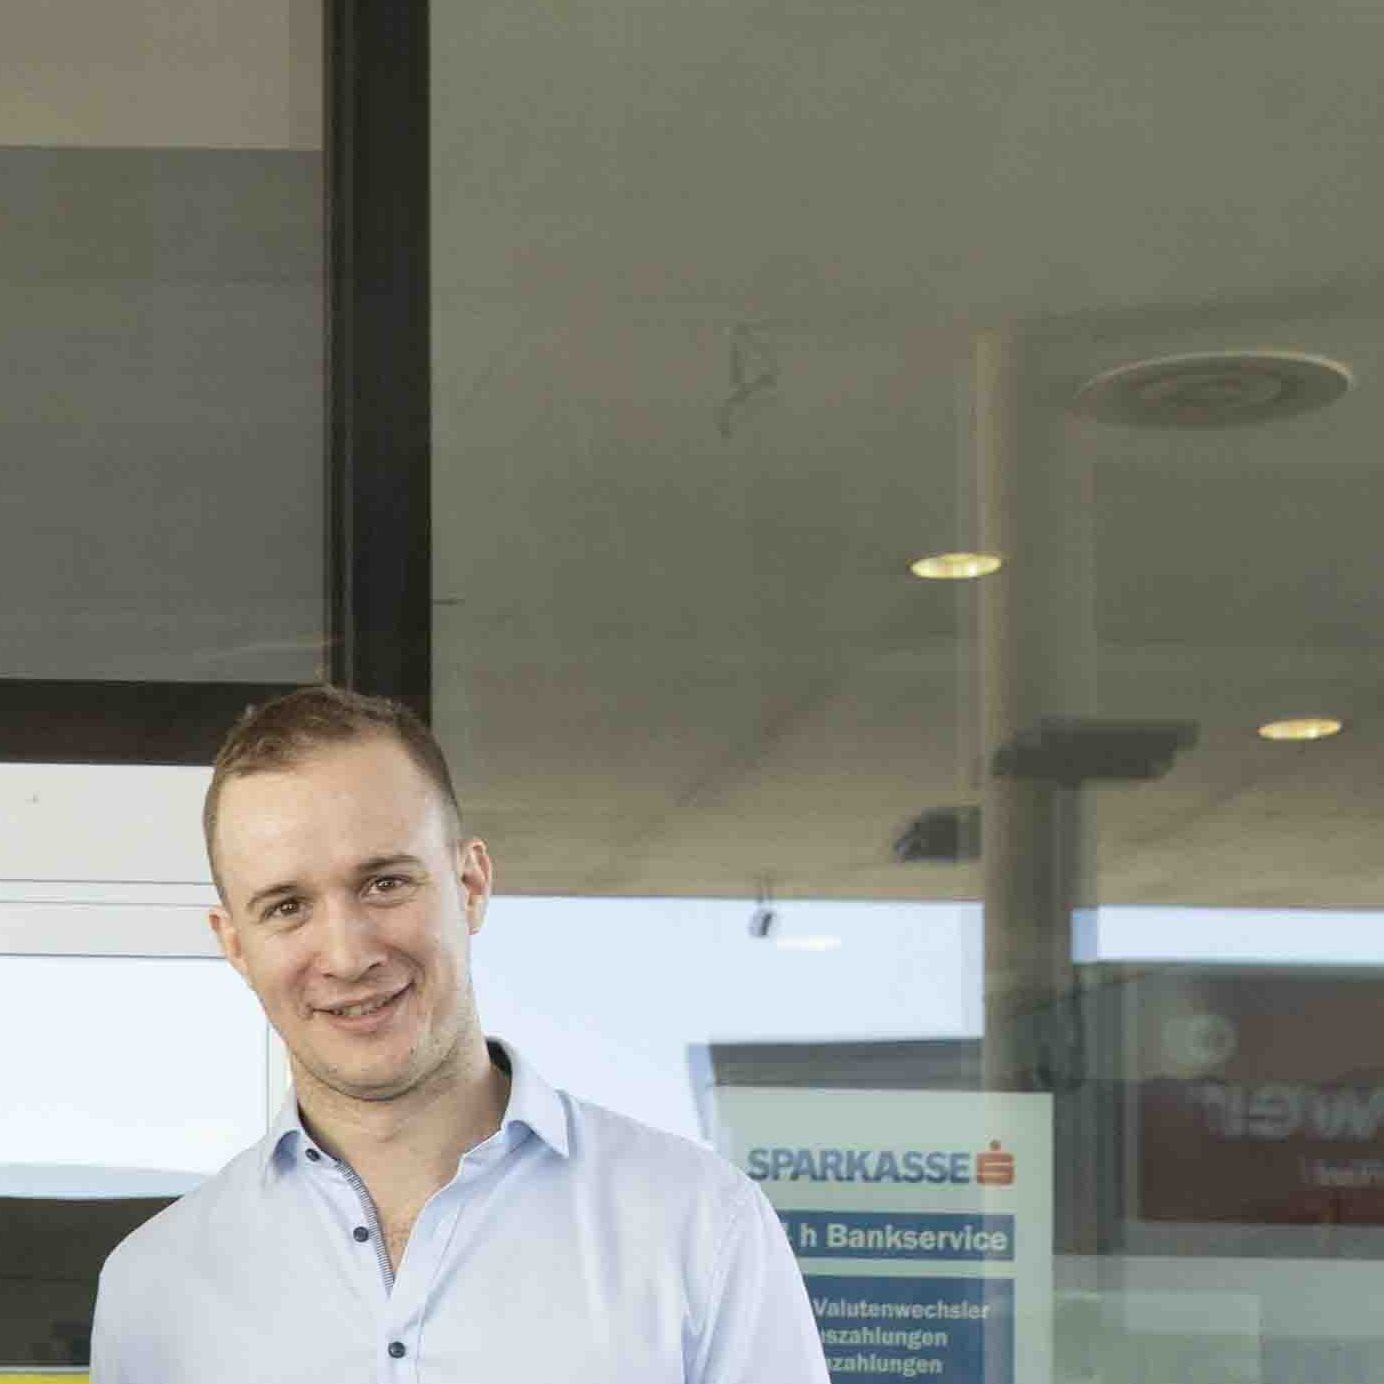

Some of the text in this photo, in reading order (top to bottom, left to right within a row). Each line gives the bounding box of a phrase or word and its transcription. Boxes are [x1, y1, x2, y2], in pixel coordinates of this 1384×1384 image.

[746, 1147, 971, 1185] SPARKASSE
[826, 1223, 1009, 1251] Bankservice
[812, 1298, 991, 1320] Valutenwechsler
